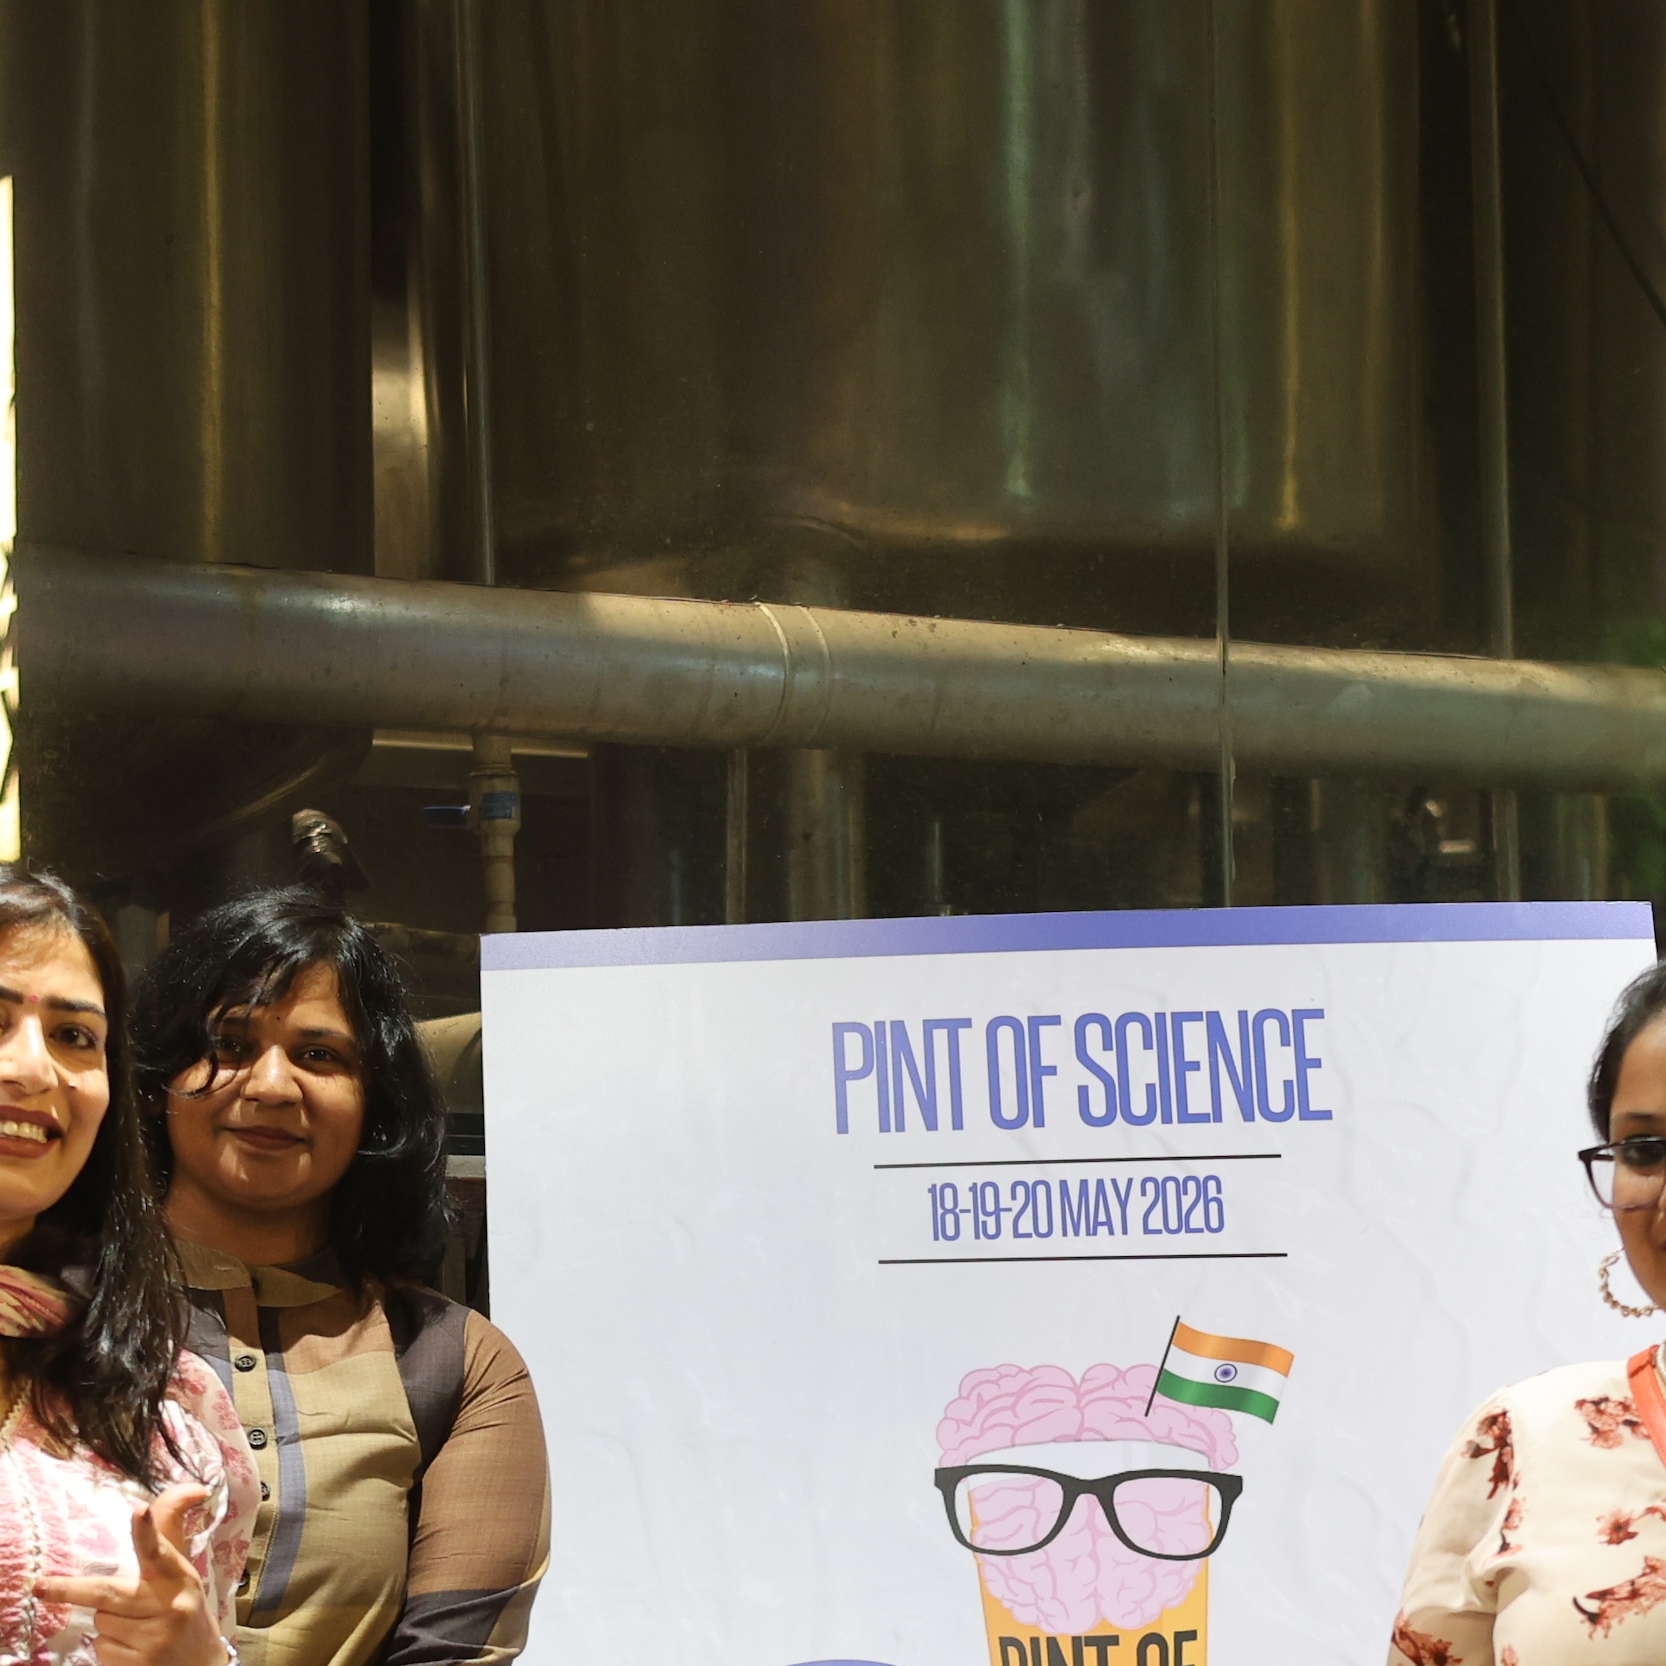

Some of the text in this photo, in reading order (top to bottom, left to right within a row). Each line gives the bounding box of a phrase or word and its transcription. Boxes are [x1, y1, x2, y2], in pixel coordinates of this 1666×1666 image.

[831, 1008, 1333, 1135] PINT OF SCIENCE
[927, 1174, 1226, 1242] 18-19-20 MAY 2026
